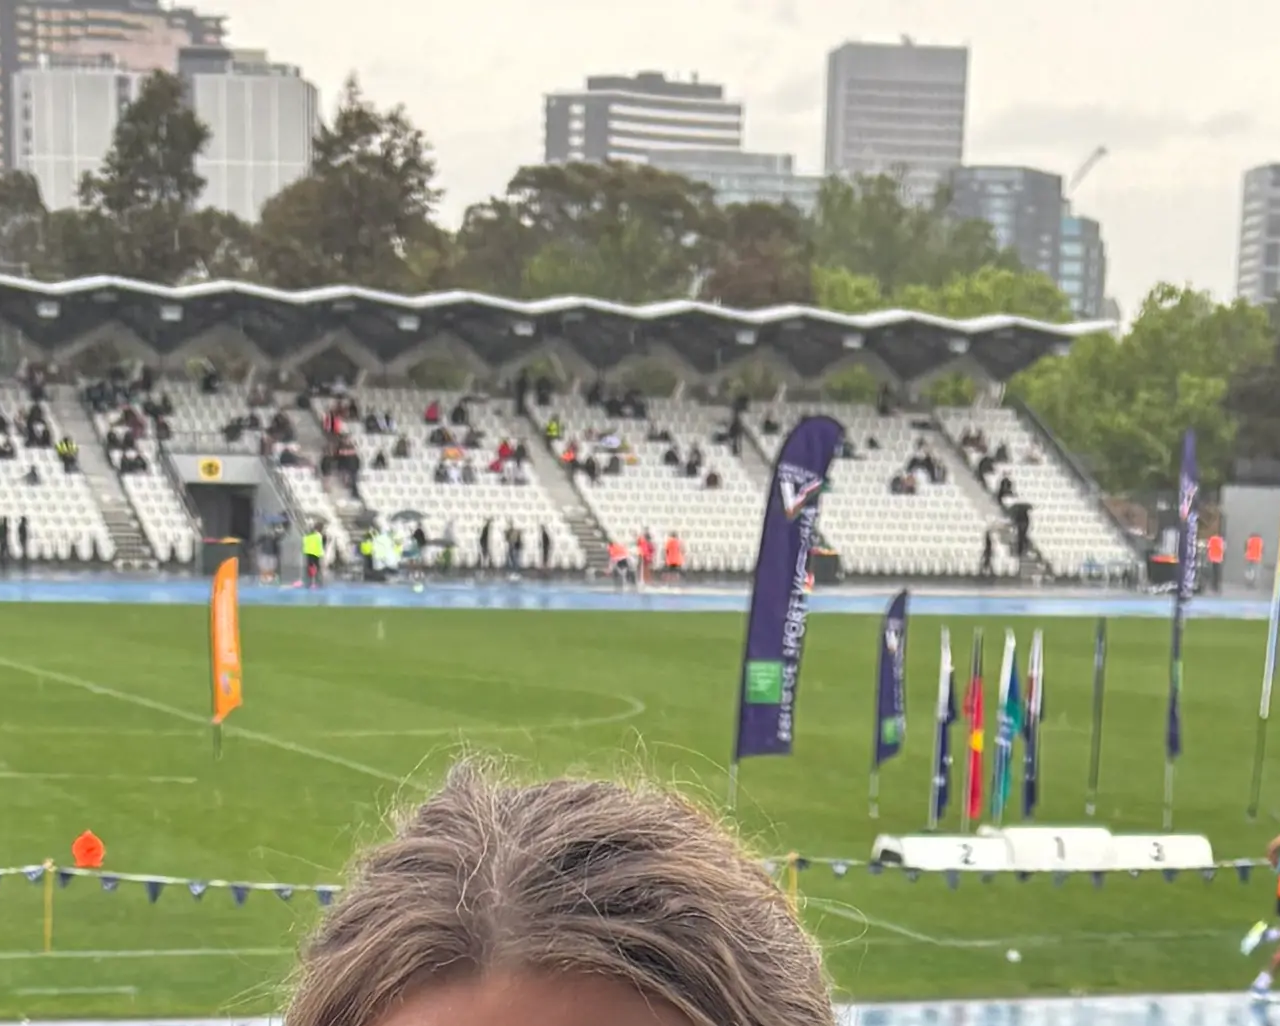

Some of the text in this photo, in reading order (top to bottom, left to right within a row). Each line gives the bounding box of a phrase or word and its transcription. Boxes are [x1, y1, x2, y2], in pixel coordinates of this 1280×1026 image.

[959, 843, 976, 865] 2
[1054, 836, 1066, 861] 1
[1150, 841, 1166, 862] 3
